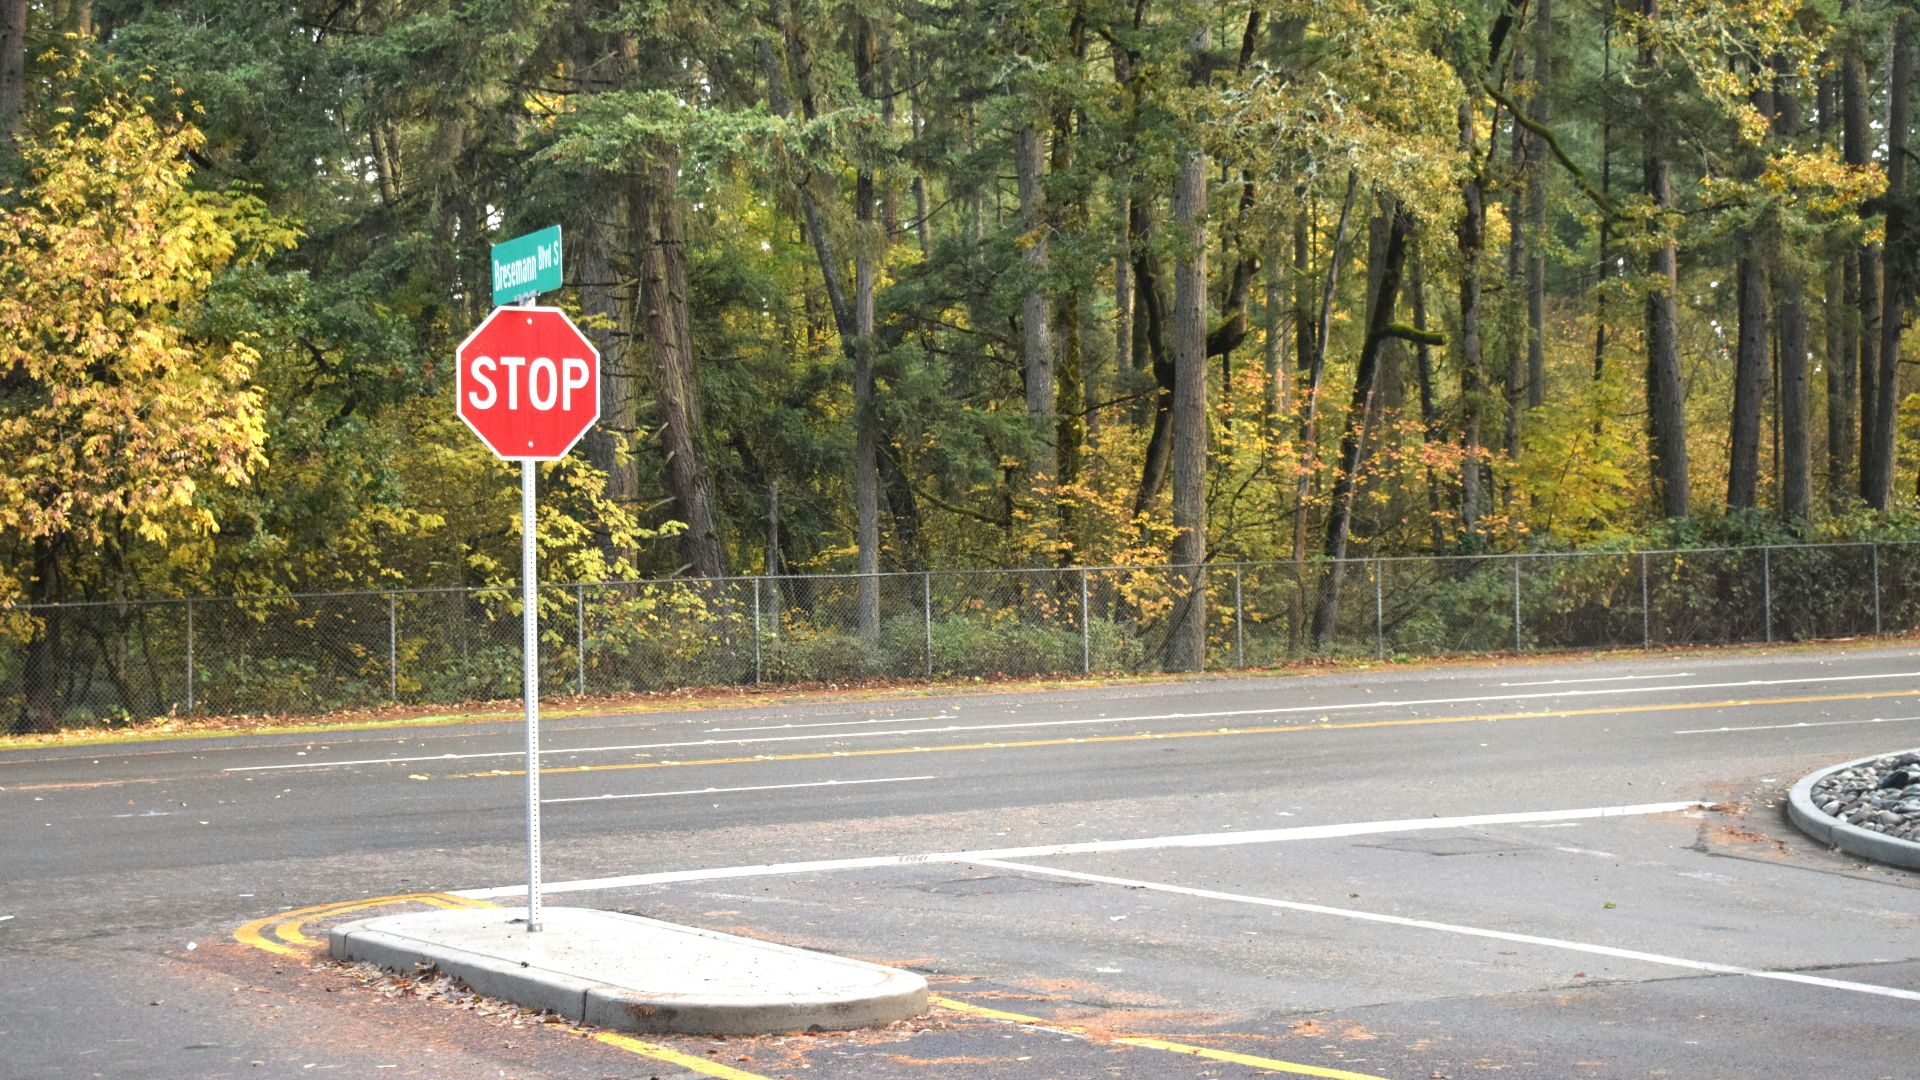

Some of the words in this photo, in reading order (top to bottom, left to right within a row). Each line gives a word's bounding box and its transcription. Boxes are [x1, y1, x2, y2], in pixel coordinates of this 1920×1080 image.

[494, 255, 537, 291] Bresemann
[538, 244, 552, 271] Blvd
[553, 240, 559, 266] S
[468, 356, 590, 411] STOP
